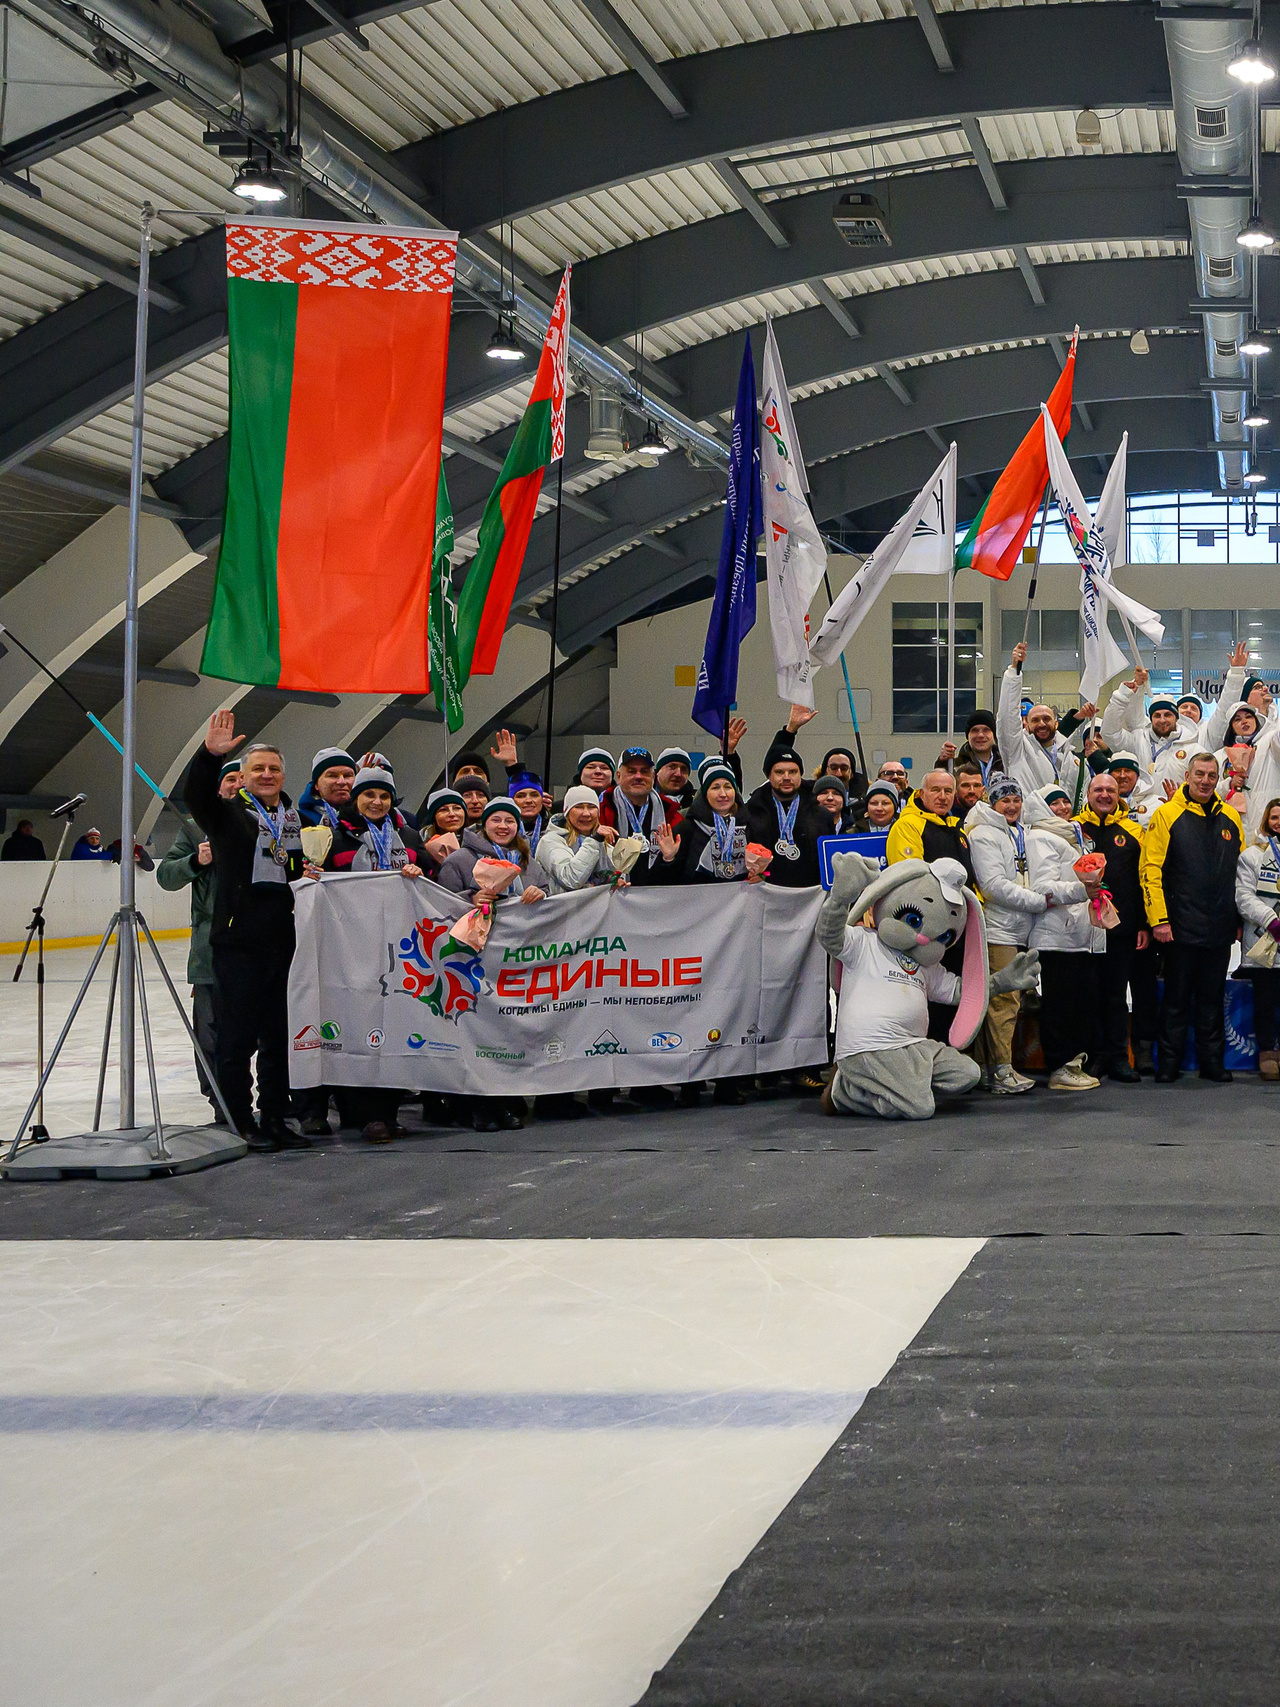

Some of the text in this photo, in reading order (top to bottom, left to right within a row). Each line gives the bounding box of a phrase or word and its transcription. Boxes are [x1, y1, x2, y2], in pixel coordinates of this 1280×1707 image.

[502, 936, 627, 963] КОМАНДА
[497, 956, 703, 1003] ЕДИНЫЕ
[498, 1005, 529, 1016] КОГДА
[532, 1005, 549, 1014] МЫ
[553, 999, 587, 1013] ЕДИНЫ
[603, 996, 622, 1006] МЫ
[625, 993, 702, 1006] НЕПОБЕДИМЫ!
[475, 1050, 526, 1060] ВОСТОЧНЫЙ
